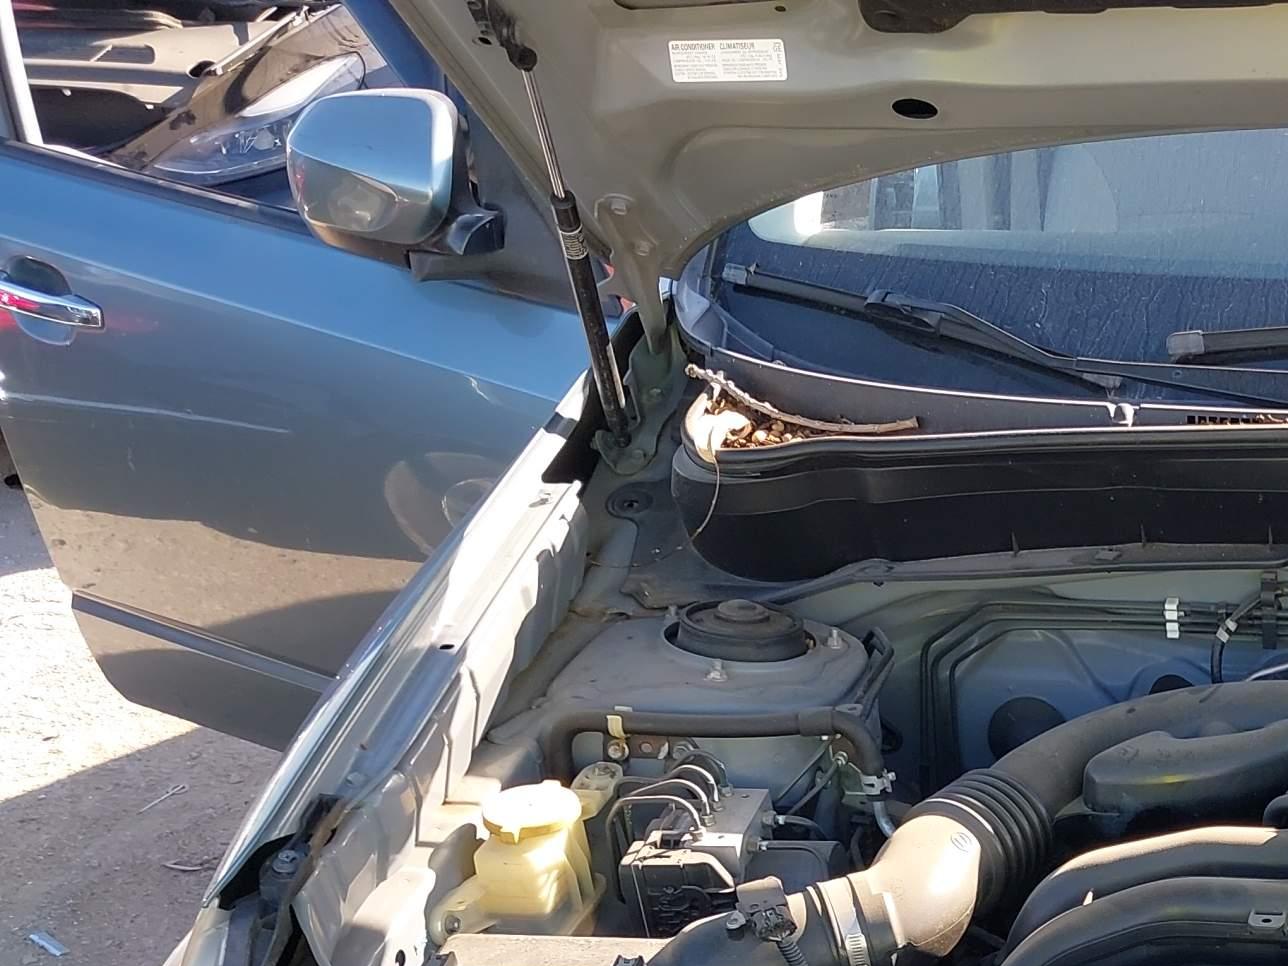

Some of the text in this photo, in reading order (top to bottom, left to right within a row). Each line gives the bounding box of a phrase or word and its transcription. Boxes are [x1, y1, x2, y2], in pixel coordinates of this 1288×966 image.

[671, 42, 716, 51] AIR CONDITIONER
[719, 42, 756, 50] CLIMATISEUR
